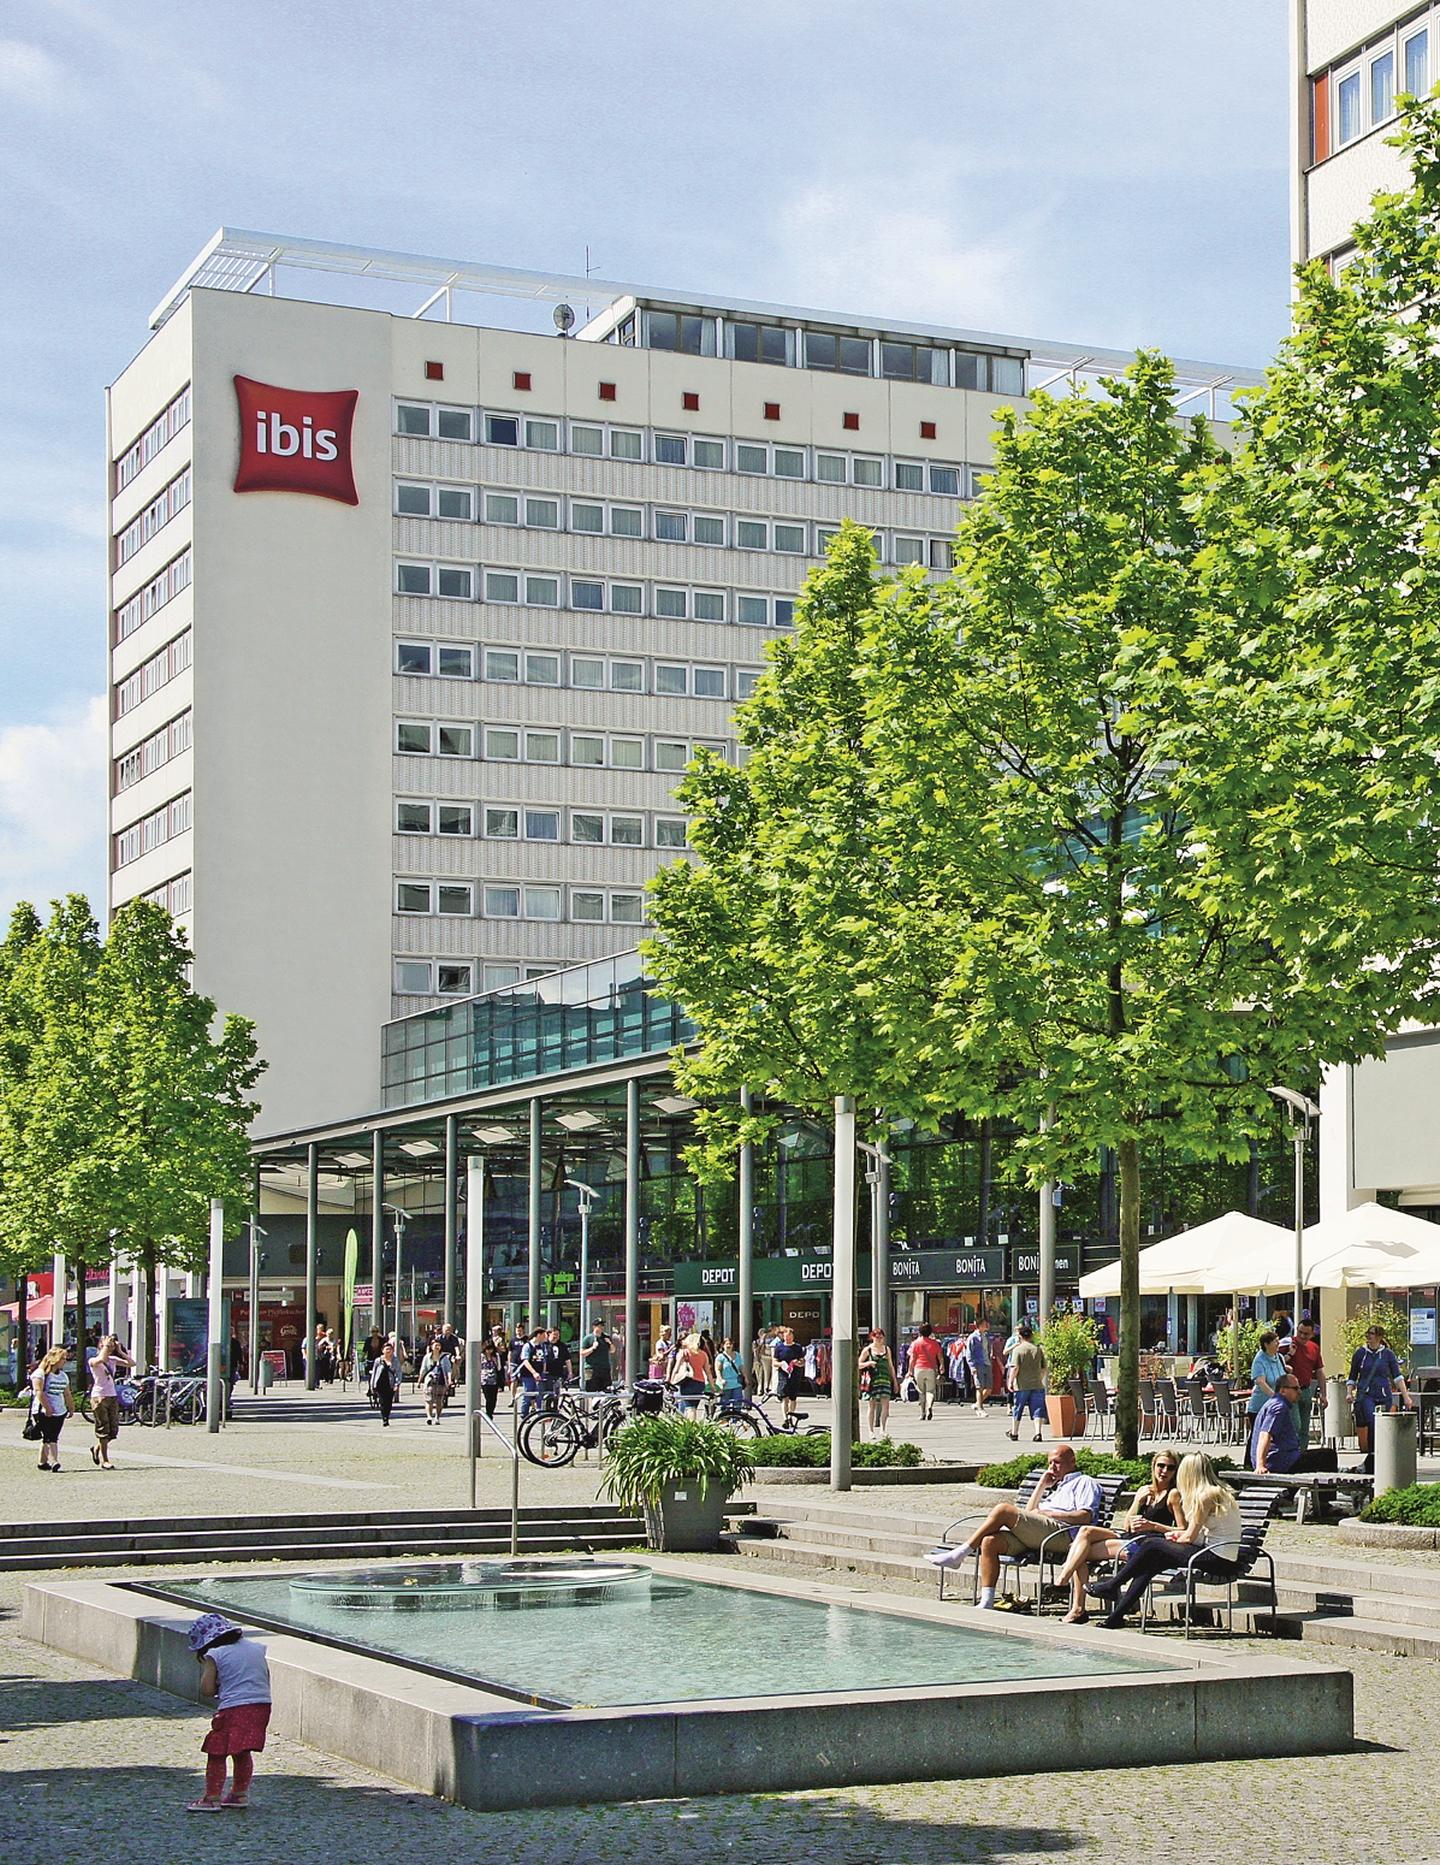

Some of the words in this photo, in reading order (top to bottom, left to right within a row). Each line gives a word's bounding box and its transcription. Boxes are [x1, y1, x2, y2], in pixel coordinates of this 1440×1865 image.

[256, 410, 338, 461] ibis
[702, 1268, 735, 1284] DEPOT
[801, 1263, 835, 1279] DEPO
